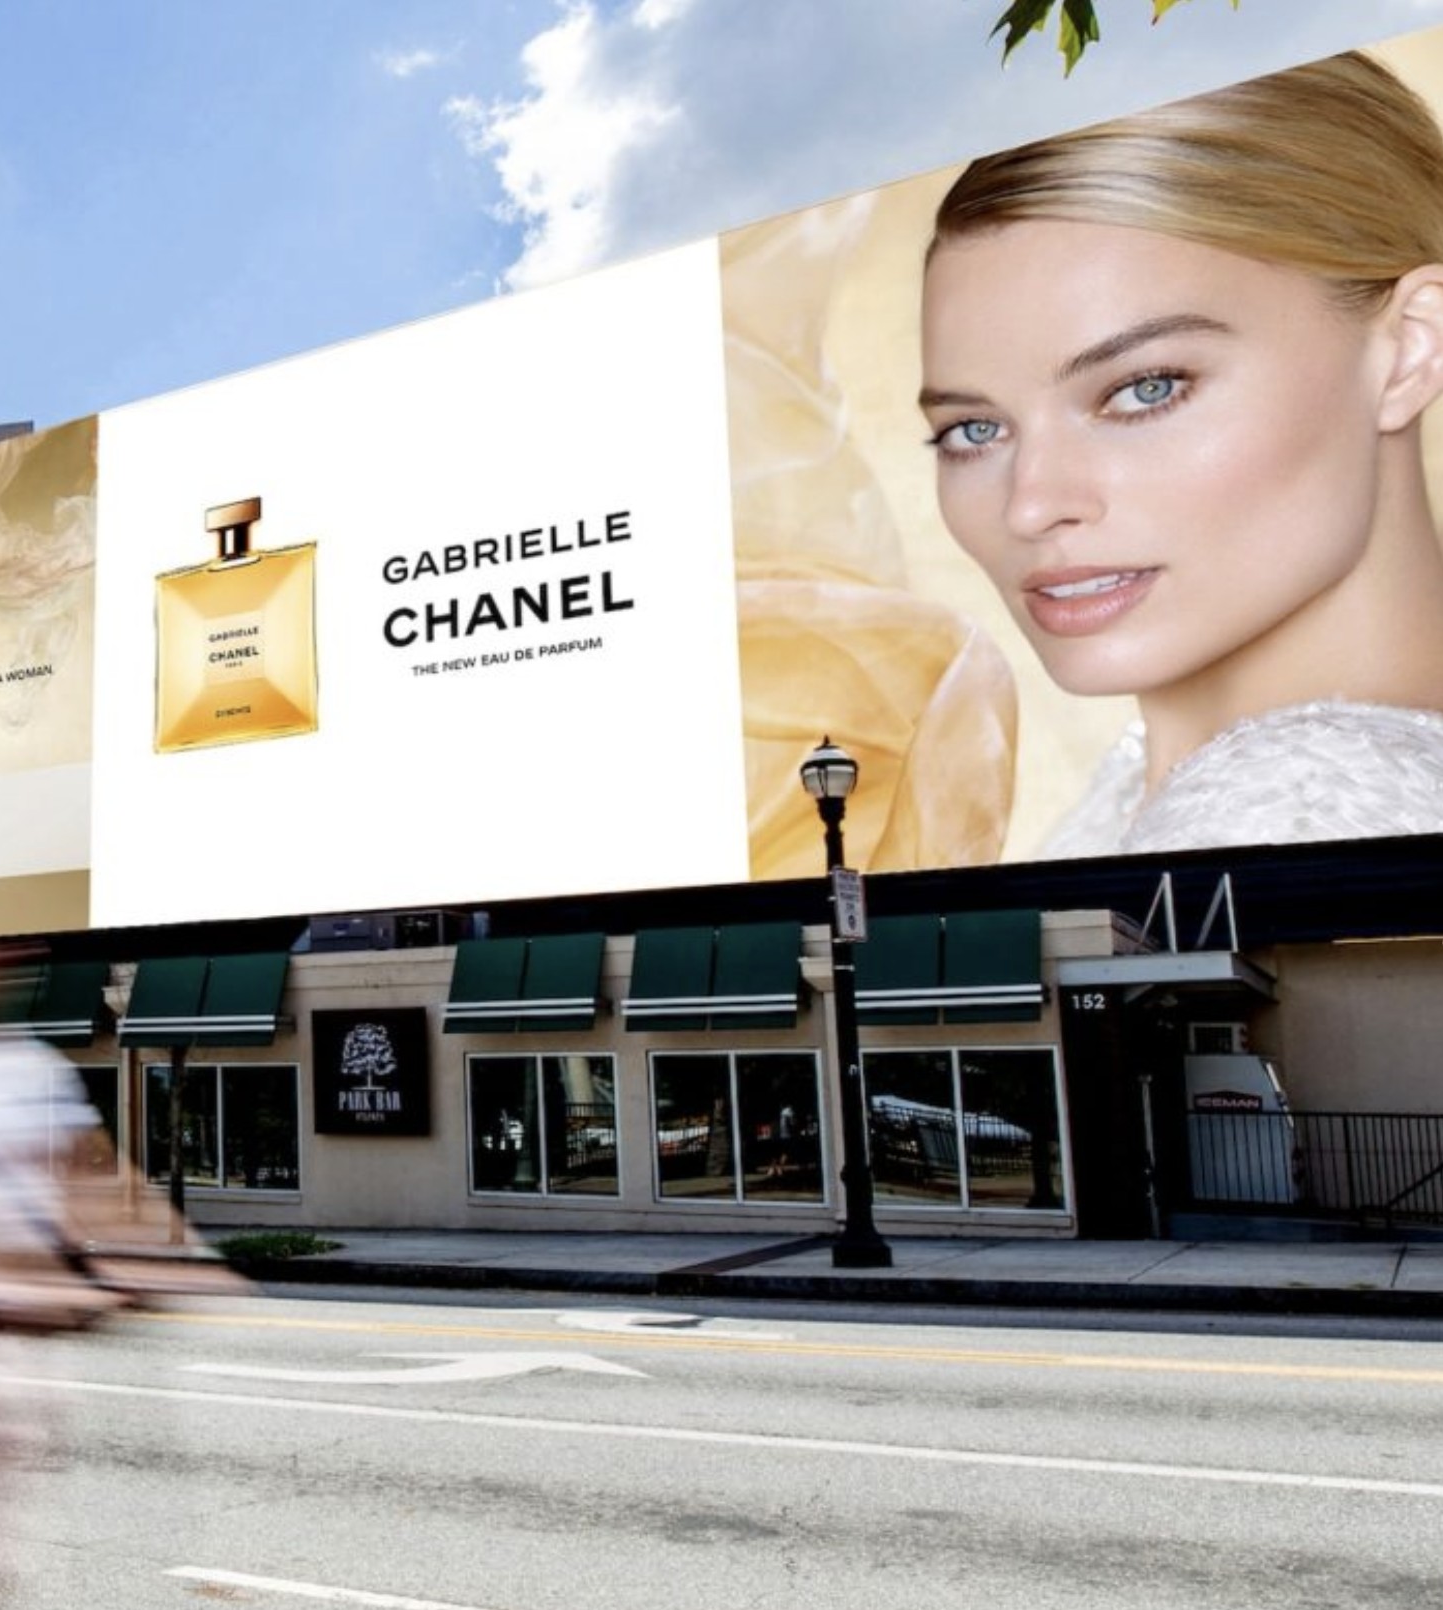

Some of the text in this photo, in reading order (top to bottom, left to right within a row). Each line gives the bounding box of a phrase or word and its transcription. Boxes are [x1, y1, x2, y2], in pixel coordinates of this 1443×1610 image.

[382, 511, 632, 585] GABRIELLE
[383, 571, 635, 647] CHANEL
[208, 646, 259, 663] CHANEL
[412, 636, 604, 676] THE NEW EAU DE PARFUM
[1072, 993, 1106, 1010] 152
[338, 1091, 401, 1110] PARK BAR
